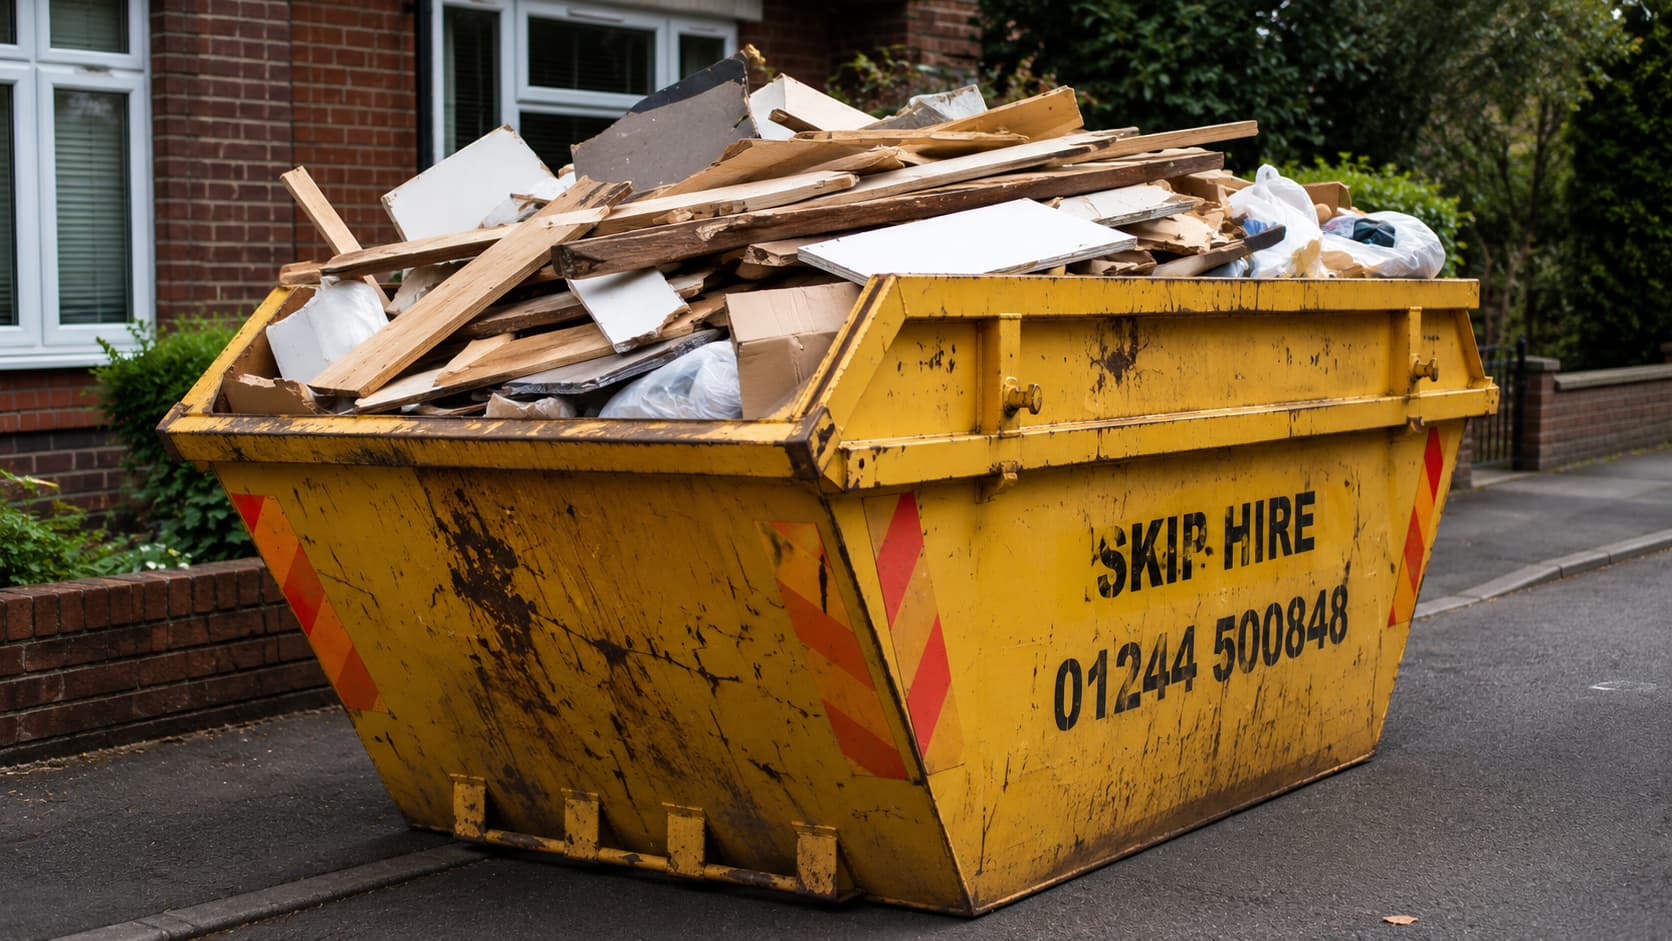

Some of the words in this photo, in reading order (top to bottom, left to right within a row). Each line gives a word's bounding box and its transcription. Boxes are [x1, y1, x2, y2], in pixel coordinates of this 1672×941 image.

[1097, 511, 1207, 598] SKIP
[1224, 491, 1315, 570] HIRE
[1054, 625, 1197, 731] 01244
[1212, 584, 1348, 682] 500848
